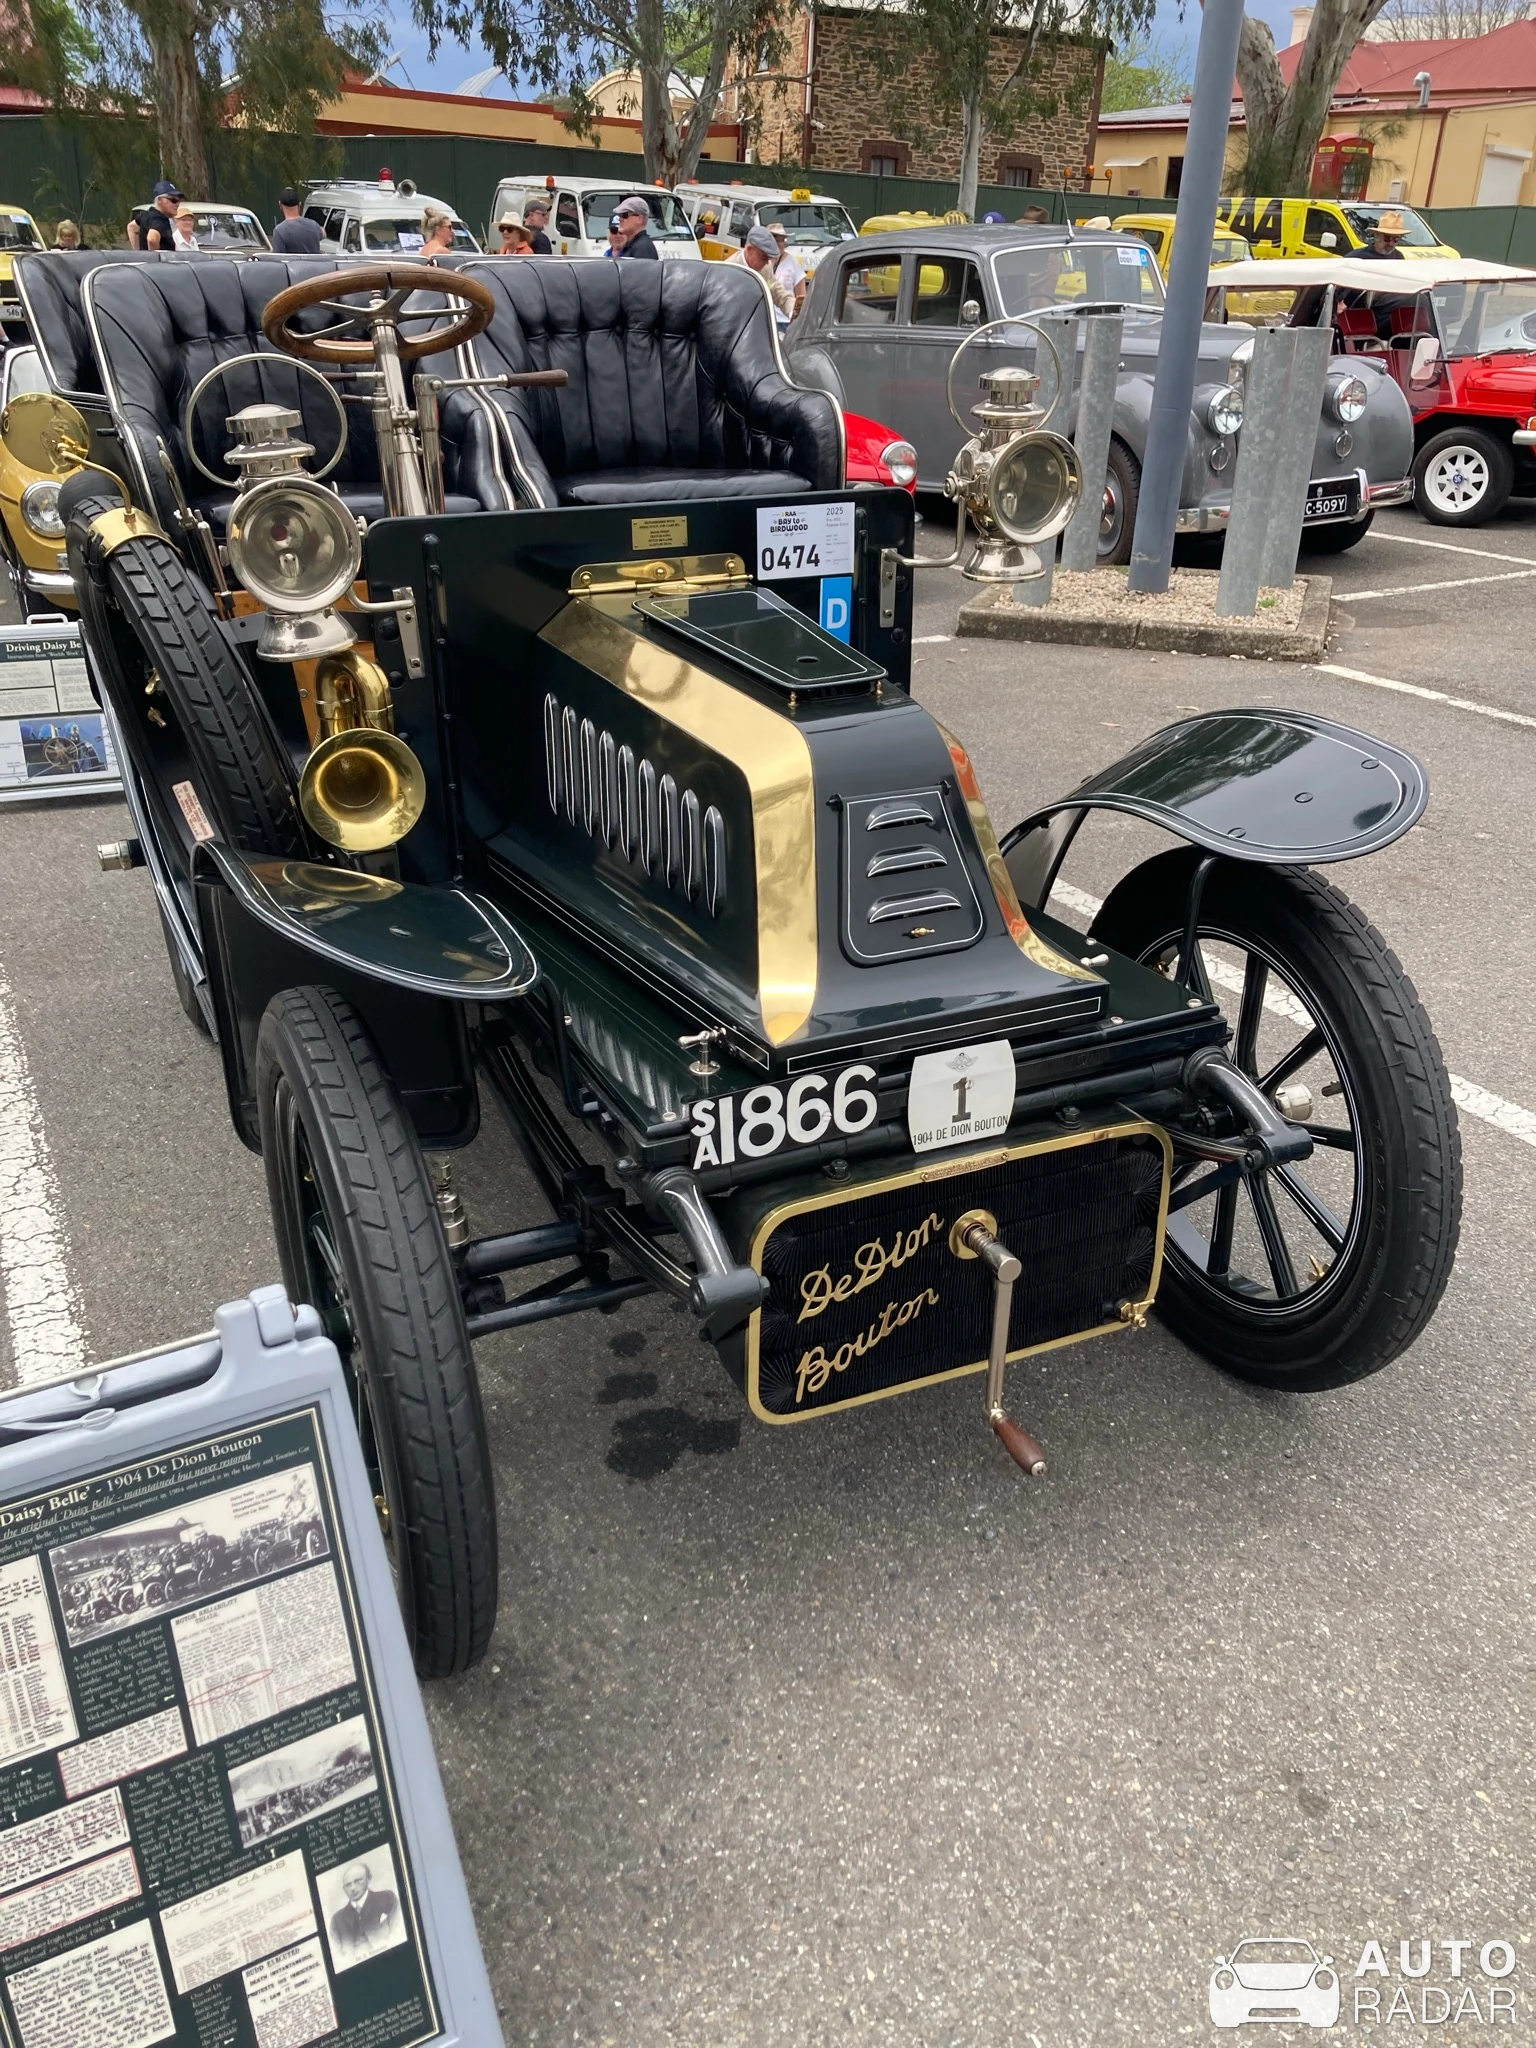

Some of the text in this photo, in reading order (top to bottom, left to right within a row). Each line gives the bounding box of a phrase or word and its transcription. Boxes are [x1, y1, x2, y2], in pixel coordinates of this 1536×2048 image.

[826, 506, 844, 516] 2025
[770, 524, 808, 533] BIRDWOOD
[762, 544, 820, 571] 0474
[826, 598, 848, 630] D
[6, 640, 82, 653] Driving Daisy Be
[952, 1076, 972, 1123] 1
[912, 1114, 1008, 1146] 1904 DE DION BOUTON
[796, 1288, 939, 1403] Bouton
[107, 1470, 141, 1490] 1904
[146, 1464, 166, 1478] De
[171, 1452, 206, 1470] Dion
[210, 1435, 261, 1457] Bouton
[3, 1528, 18, 1538] the
[20, 1514, 57, 1533] original
[124, 1476, 174, 1498] maintained
[177, 1470, 192, 1481] but
[194, 1463, 217, 1475] never
[219, 1449, 251, 1467] restored
[14, 1537, 33, 1547] Daisy
[35, 1530, 51, 1540] Belle
[70, 1519, 88, 1528] Dion
[90, 1510, 114, 1522] Bouton
[122, 1496, 157, 1510] horsepower
[185, 1480, 198, 1490] and
[198, 1475, 215, 1485] raced
[241, 1462, 260, 1471] Heavy
[262, 1455, 273, 1464] and
[44, 1537, 58, 1546] only
[60, 1532, 77, 1541] came
[175, 1597, 236, 1625] MOTOR RELIABILITY
[82, 1644, 112, 1658] reliability
[117, 1635, 131, 1646] trial
[134, 1624, 162, 1639] followed
[74, 1661, 89, 1671] with
[117, 1644, 137, 1655] Victor
[76, 1659, 120, 1679] Unfortunately
[152, 1640, 166, 1650] had
[78, 1675, 101, 1688] trouble
[105, 1668, 120, 1677] with
[155, 1648, 168, 1659] and
[117, 1673, 131, 1682] near
[82, 1695, 94, 1705] and
[99, 1684, 122, 1698] instead
[155, 1887, 174, 1897] When
[177, 1880, 189, 1888] cars
[191, 1873, 206, 1882] were
[223, 1852, 252, 1868] registered
[264, 1836, 289, 1850] Australia
[176, 1887, 193, 1898] Daisy
[194, 1880, 209, 1889] Belle
[223, 1860, 256, 1876] registration
[162, 1886, 228, 1920] MOTOR
[236, 1859, 285, 1886] CARS
[266, 1948, 299, 1967] EXECUTED
